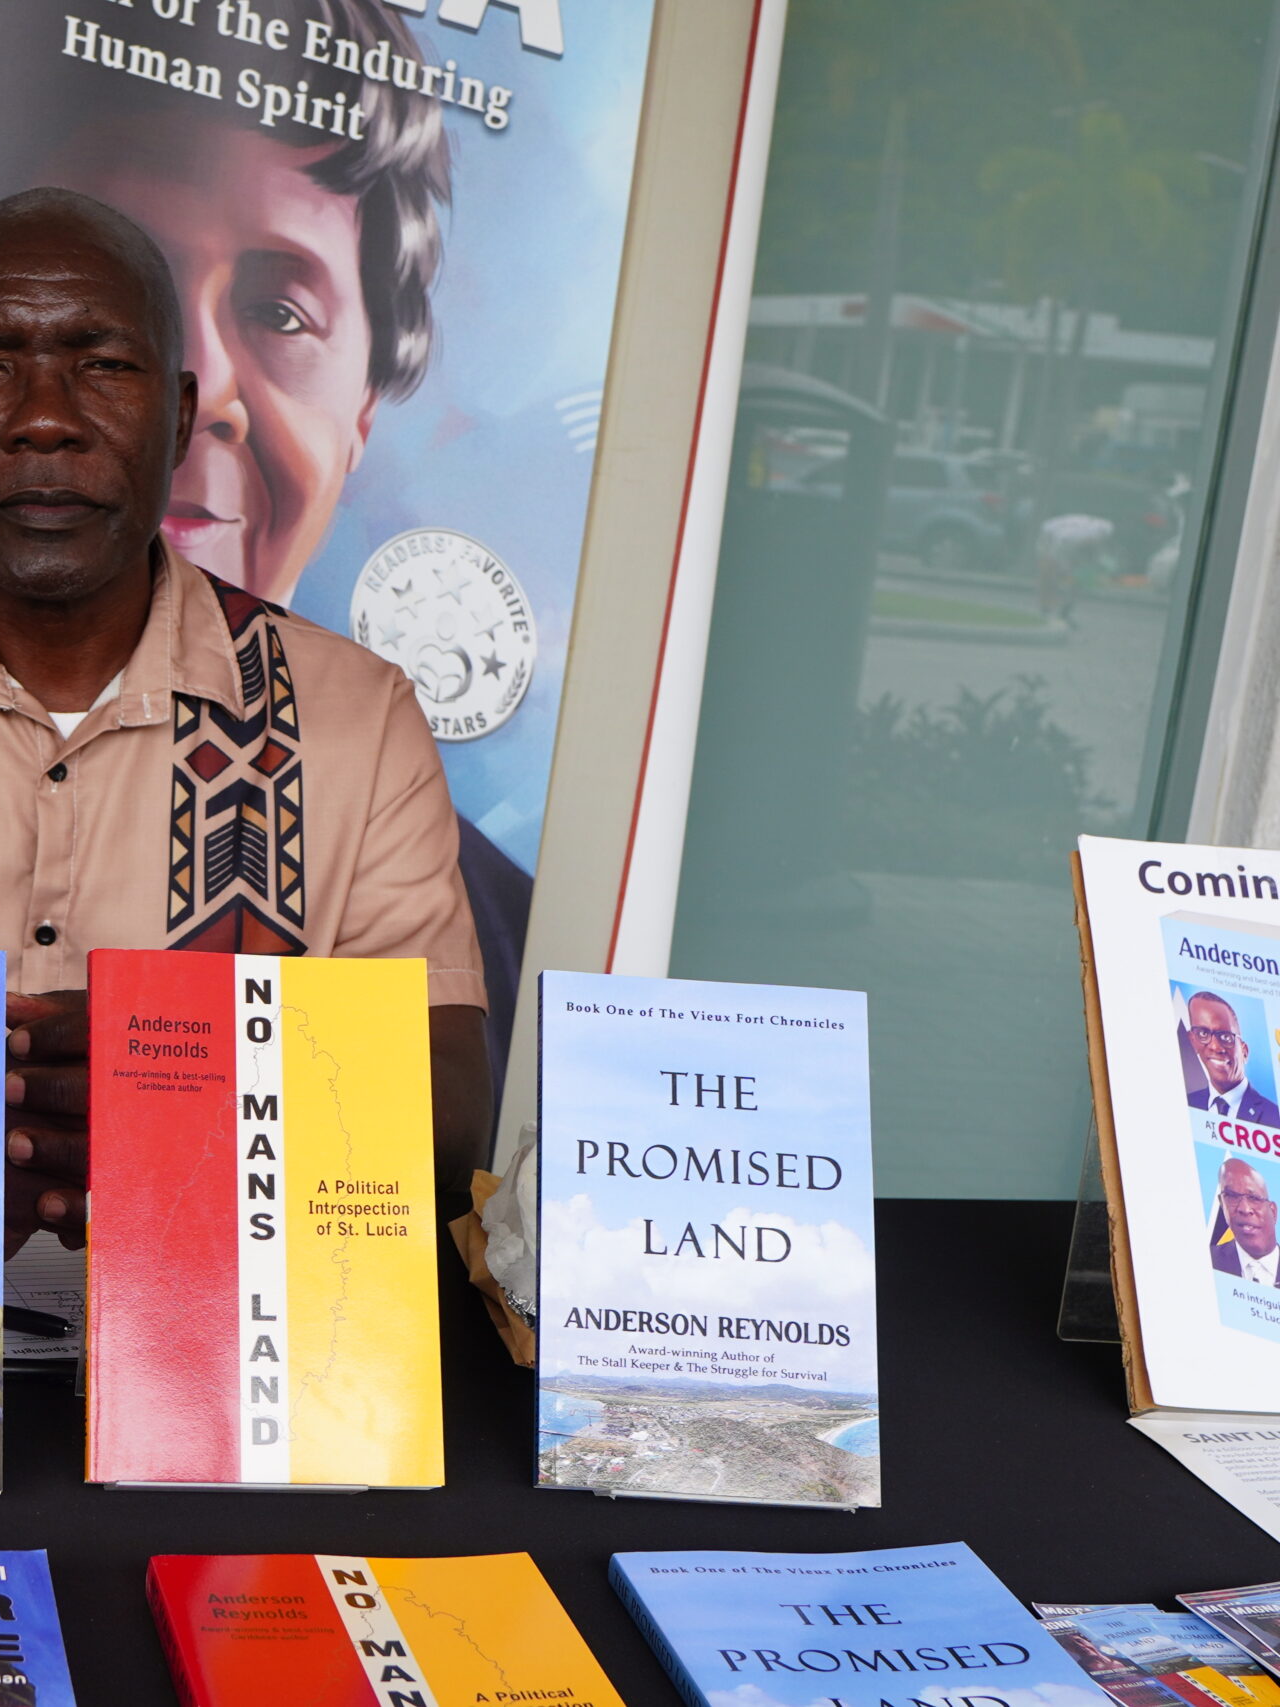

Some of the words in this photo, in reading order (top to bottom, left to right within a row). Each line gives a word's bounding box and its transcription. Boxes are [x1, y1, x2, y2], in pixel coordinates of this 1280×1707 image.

[62, 11, 222, 100] Human
[235, 69, 365, 140] Spirit
[217, 0, 289, 50] the
[302, 18, 513, 131] Enduring
[430, 712, 488, 735] STARS
[1138, 860, 1279, 900] Comin
[1179, 937, 1279, 976] Anderson
[245, 978, 272, 1043] NO
[566, 1001, 600, 1013] Book
[606, 1005, 634, 1016] One
[639, 1007, 653, 1017] of
[659, 1008, 684, 1019] The
[690, 1010, 730, 1022] Vieux
[736, 1013, 764, 1024] Fort
[770, 1015, 844, 1030] Chronicles
[127, 1015, 211, 1034] Anderson
[128, 1039, 208, 1060] Reynolds
[112, 1069, 171, 1081] Award-winning
[173, 1071, 180, 1080] &
[181, 1071, 226, 1083] best-selling
[136, 1081, 176, 1091] Caribbean
[178, 1084, 203, 1093] author
[660, 1070, 758, 1111] THE
[1205, 1120, 1216, 1131] AT
[1211, 1131, 1218, 1140] A
[243, 1094, 278, 1240] MANS
[577, 1140, 842, 1190] PROMISED
[317, 1180, 328, 1194] A
[335, 1180, 399, 1195] Political
[309, 1200, 409, 1218] Introspection
[316, 1221, 332, 1236] of
[338, 1221, 359, 1236] St.
[366, 1222, 407, 1236] Lucia
[643, 1219, 791, 1263] LAND
[1233, 1288, 1245, 1299] An
[564, 1307, 707, 1337] ANDERSON
[718, 1316, 850, 1347] REYNOLDS
[12, 1345, 69, 1355] Spotlight
[628, 1344, 718, 1363] Award-winning
[720, 1351, 760, 1362] Author
[763, 1353, 775, 1363] of
[250, 1294, 279, 1446] LAND
[577, 1355, 599, 1366] The
[602, 1357, 627, 1368] Stall
[631, 1359, 671, 1373] Keeper
[673, 1362, 683, 1372] &
[686, 1362, 708, 1374] The
[710, 1364, 759, 1379] Struggle
[761, 1367, 778, 1378] for
[781, 1369, 827, 1382] Survival
[1182, 1431, 1254, 1442] SAINT
[780, 1603, 902, 1626] THE
[719, 1642, 1030, 1672] PROMISED
